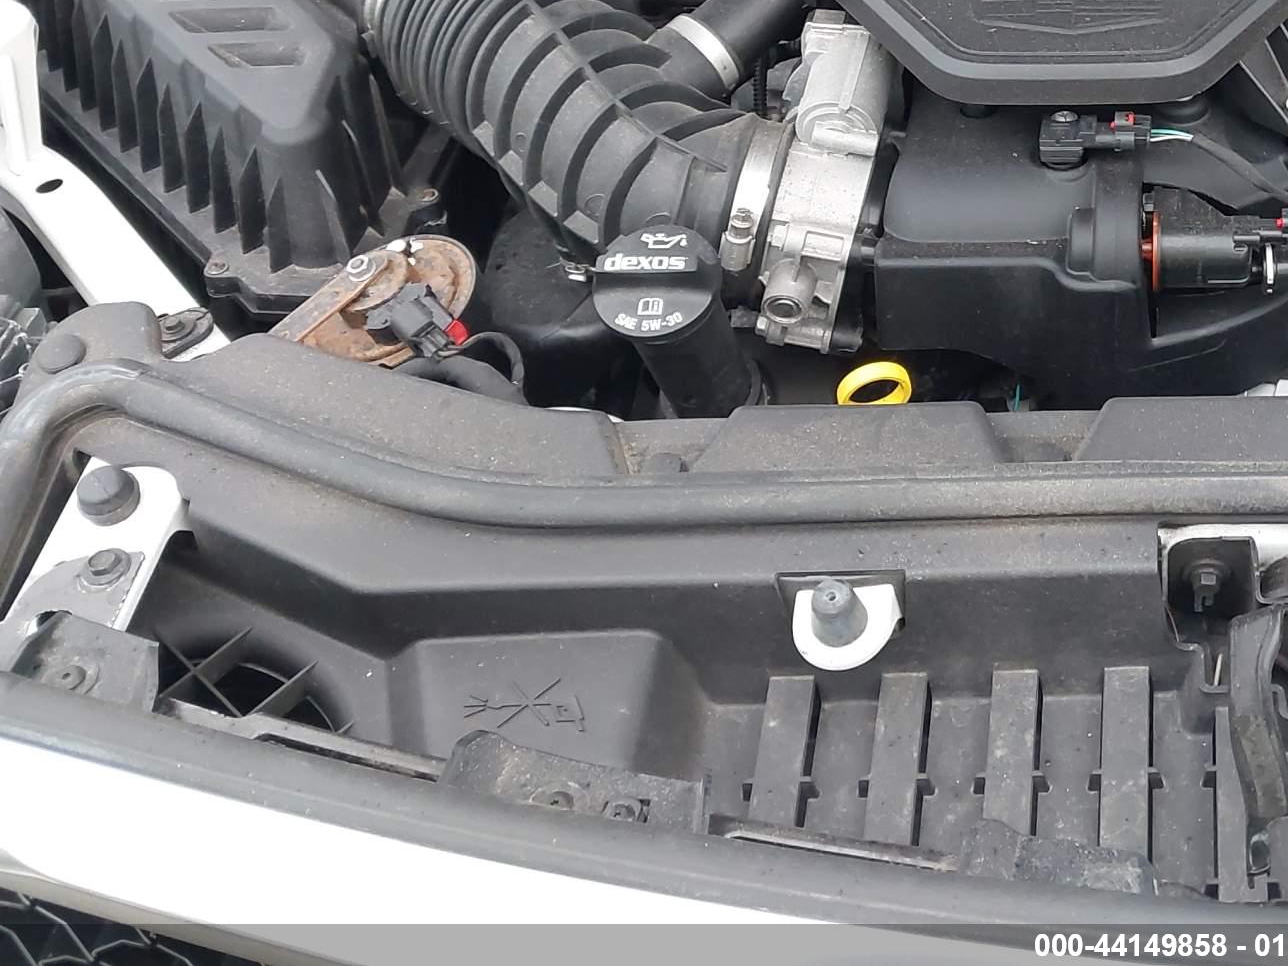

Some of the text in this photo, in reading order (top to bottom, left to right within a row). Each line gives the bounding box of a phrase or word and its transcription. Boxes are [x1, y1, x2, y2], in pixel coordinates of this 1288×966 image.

[603, 253, 687, 271] dexos
[614, 311, 683, 331] SAE 5W-30
